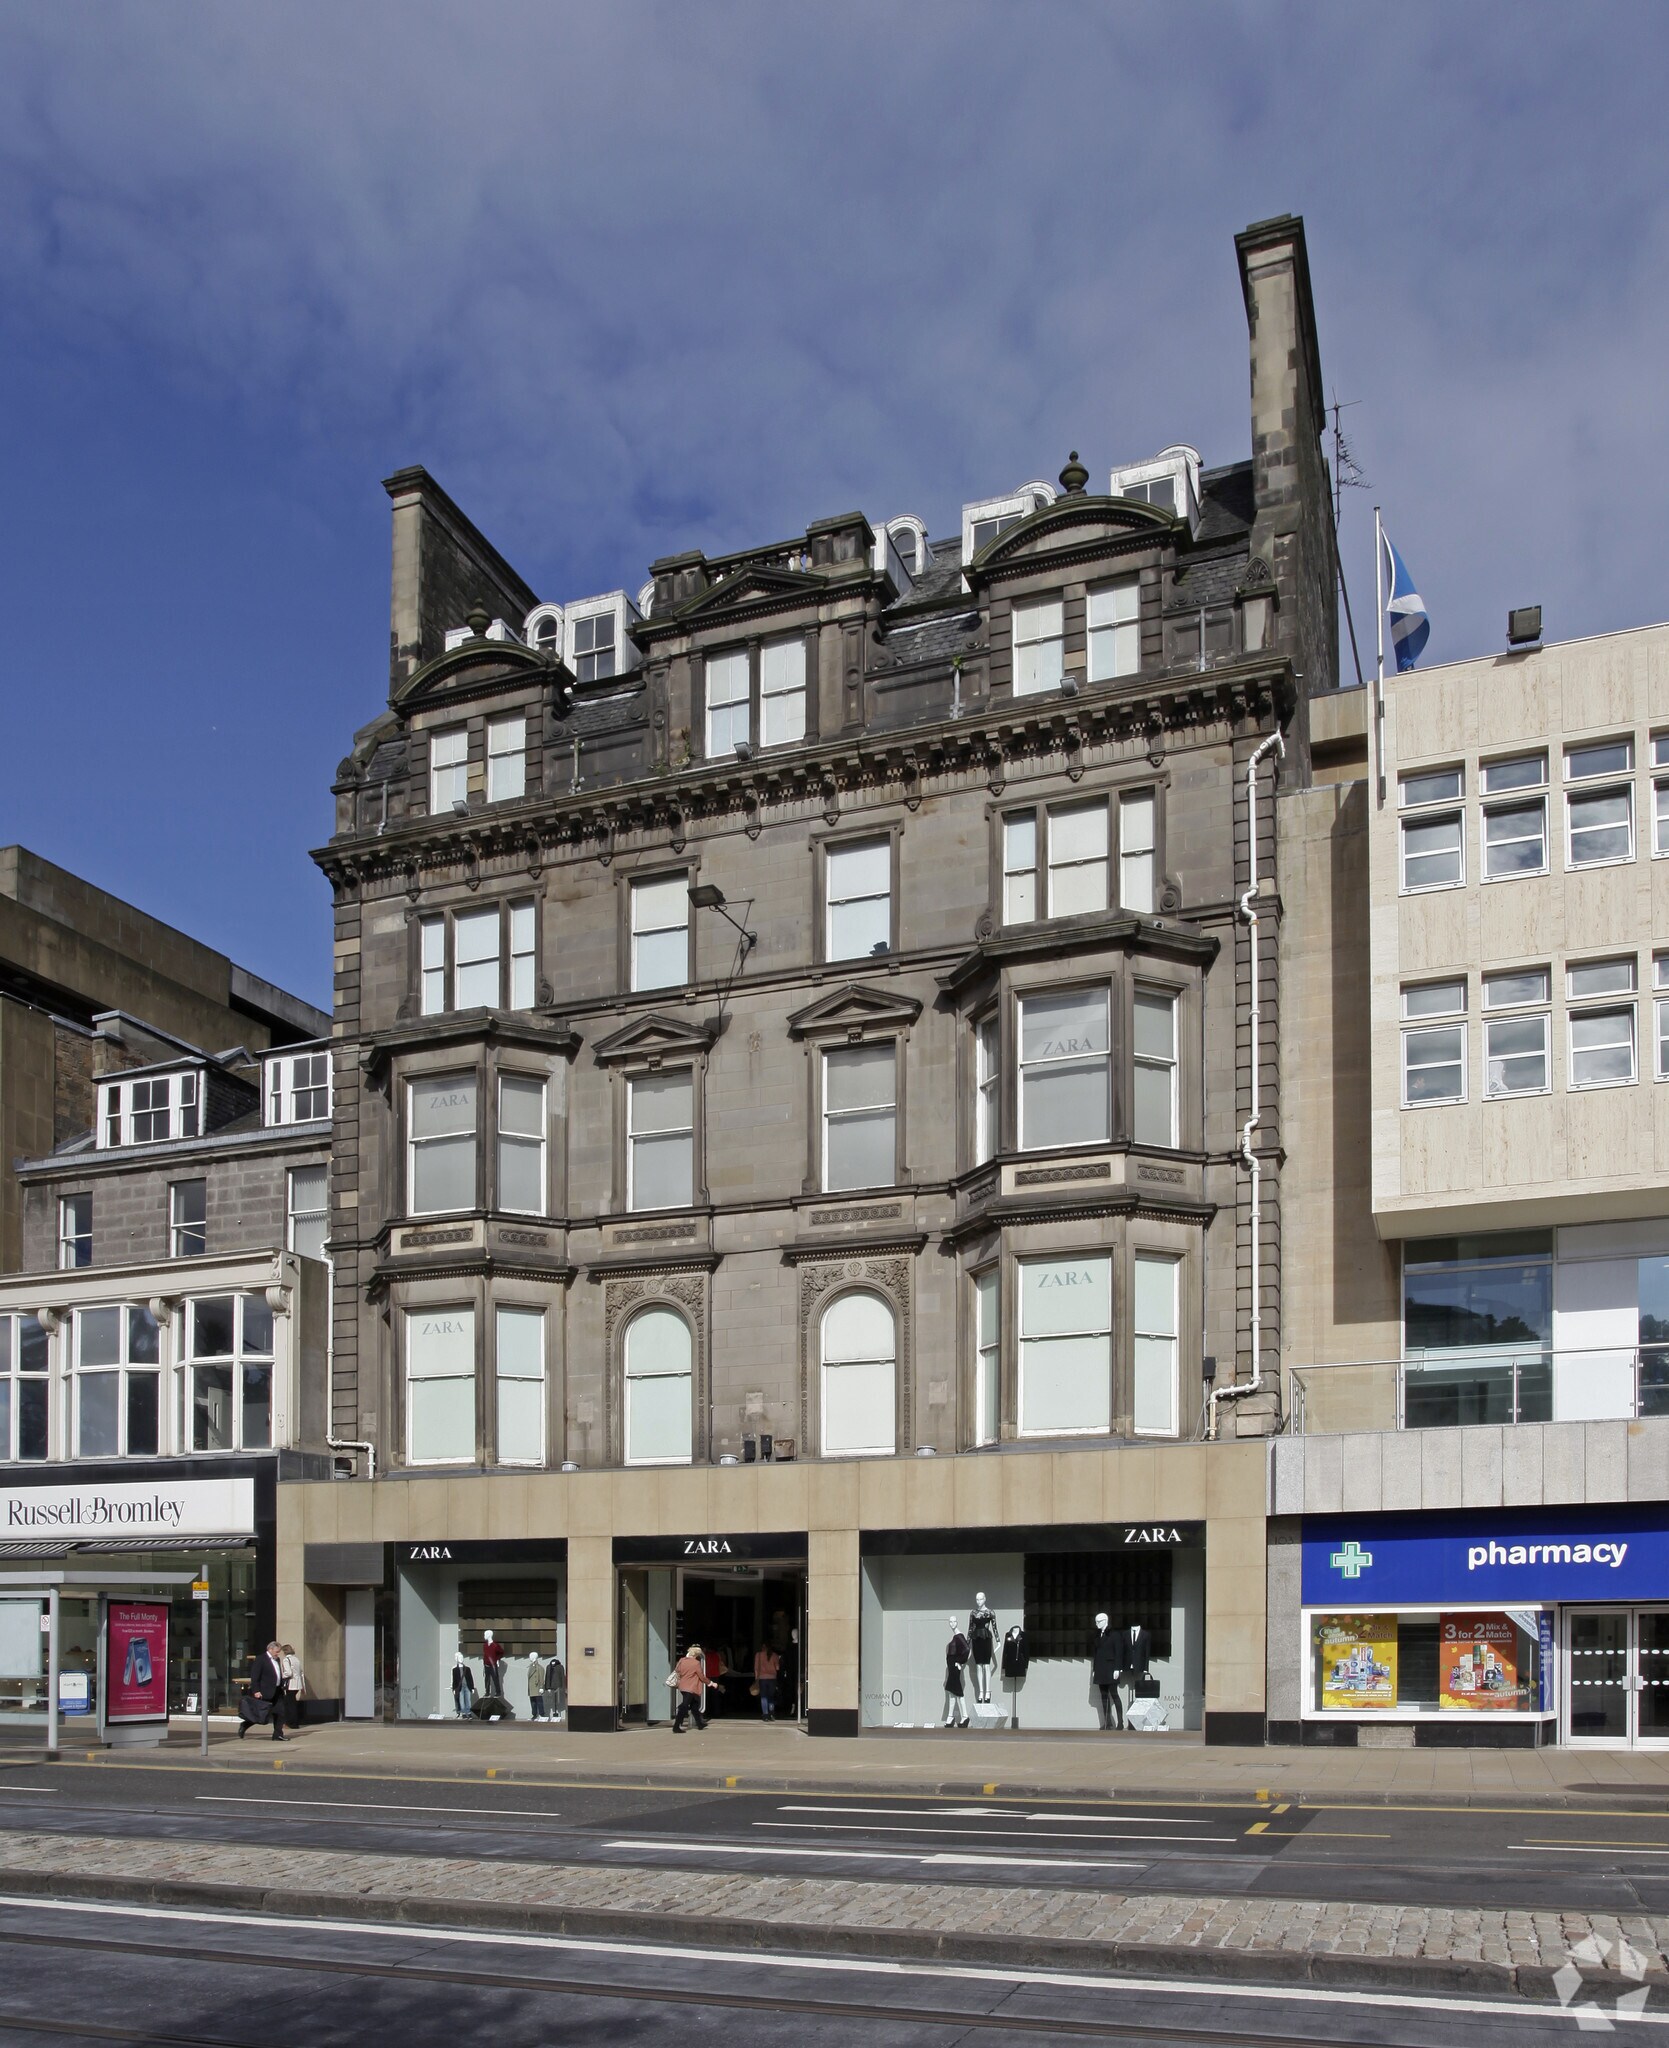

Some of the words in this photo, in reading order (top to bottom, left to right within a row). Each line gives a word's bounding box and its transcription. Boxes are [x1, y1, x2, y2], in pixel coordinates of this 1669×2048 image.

[1042, 1037, 1094, 1055] ZARA
[430, 1093, 469, 1109] ZARA
[1037, 1271, 1094, 1288] ZARA
[422, 1321, 465, 1335] ZARA
[1124, 1527, 1182, 1543] ZARA
[410, 1546, 452, 1559] ZARA
[684, 1540, 732, 1554] ZARA
[1468, 1541, 1628, 1570] pharmacy
[119, 1612, 130, 1620] The
[130, 1612, 141, 1621] Full
[141, 1613, 158, 1622] Monty
[1368, 1631, 1393, 1639] Match
[1445, 1623, 1457, 1639] 3
[1458, 1630, 1473, 1639] for
[1474, 1623, 1485, 1639] 2
[1486, 1631, 1512, 1639] Match
[1324, 1634, 1356, 1644] autumn
[891, 1689, 903, 1707] 0
[1494, 1688, 1527, 1698] autumn
